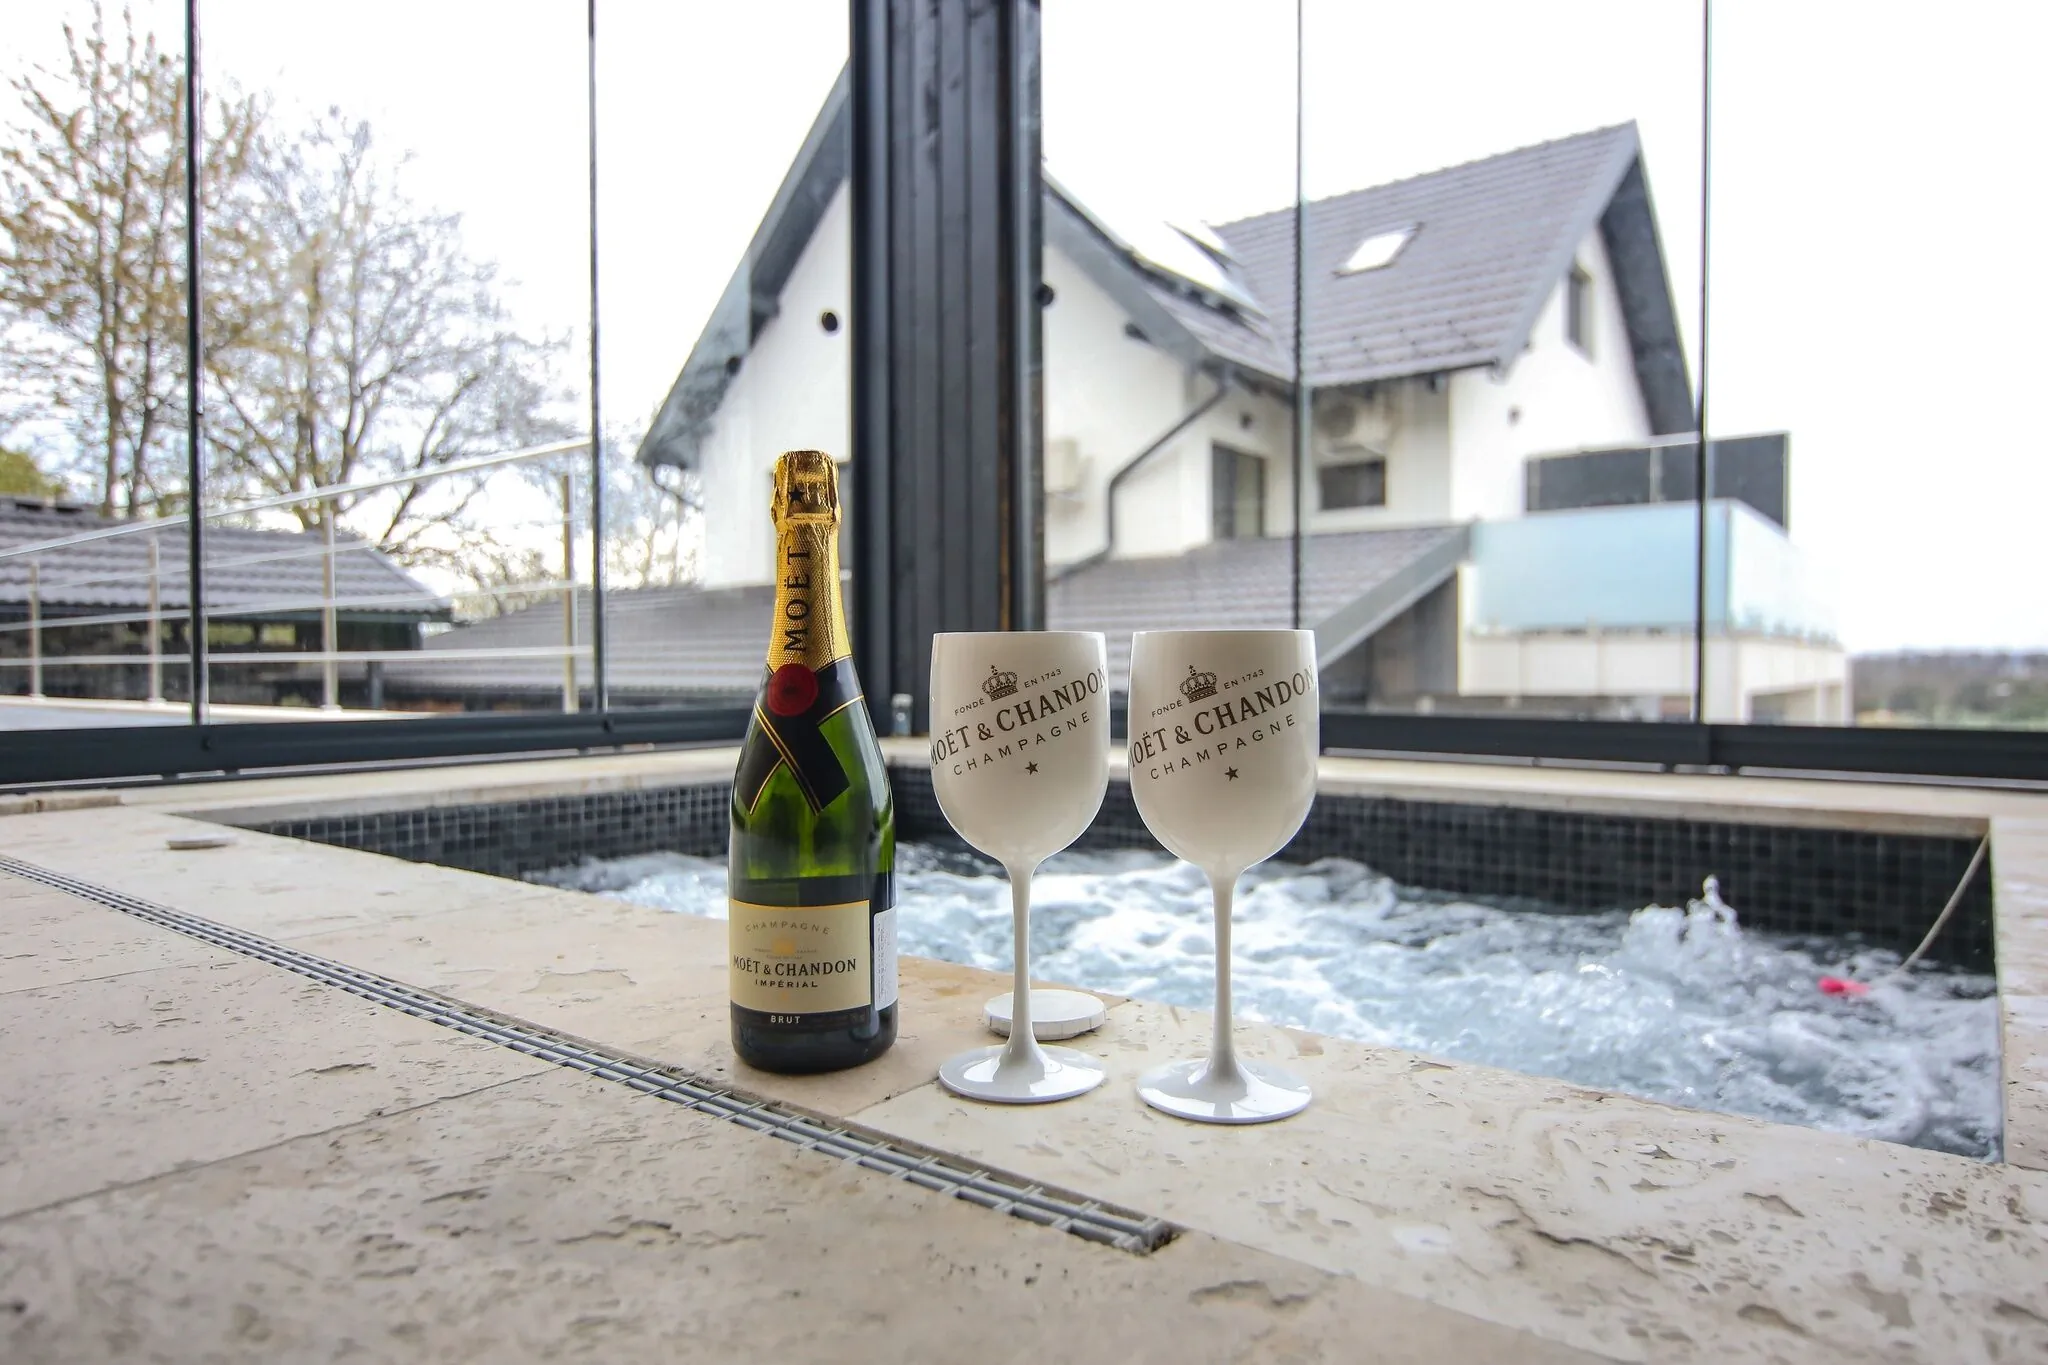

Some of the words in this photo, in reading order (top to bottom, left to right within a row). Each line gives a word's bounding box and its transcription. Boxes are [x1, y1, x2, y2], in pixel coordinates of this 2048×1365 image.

[783, 545, 811, 652] MOËT
[954, 698, 985, 716] FONDÉ
[1024, 678, 1038, 689] EN
[1041, 668, 1062, 683] 1743
[976, 722, 994, 741] &
[996, 665, 1107, 732] CHANDON
[1151, 699, 1183, 718] FONDÉ
[1223, 679, 1239, 690] EN
[1241, 668, 1265, 684] 1743
[1174, 725, 1193, 745] &
[1194, 664, 1314, 735] CHANDON
[953, 711, 1090, 776] CHAMPAGNE
[1150, 713, 1296, 780] CHAMPAGNE
[745, 920, 831, 936] CHAMPAGNE
[733, 954, 761, 975] MOËT
[763, 964, 772, 976] &
[774, 957, 858, 977] CHANDON
[755, 978, 819, 989] IMPÉRIAL
[770, 1014, 801, 1024] BRUT
